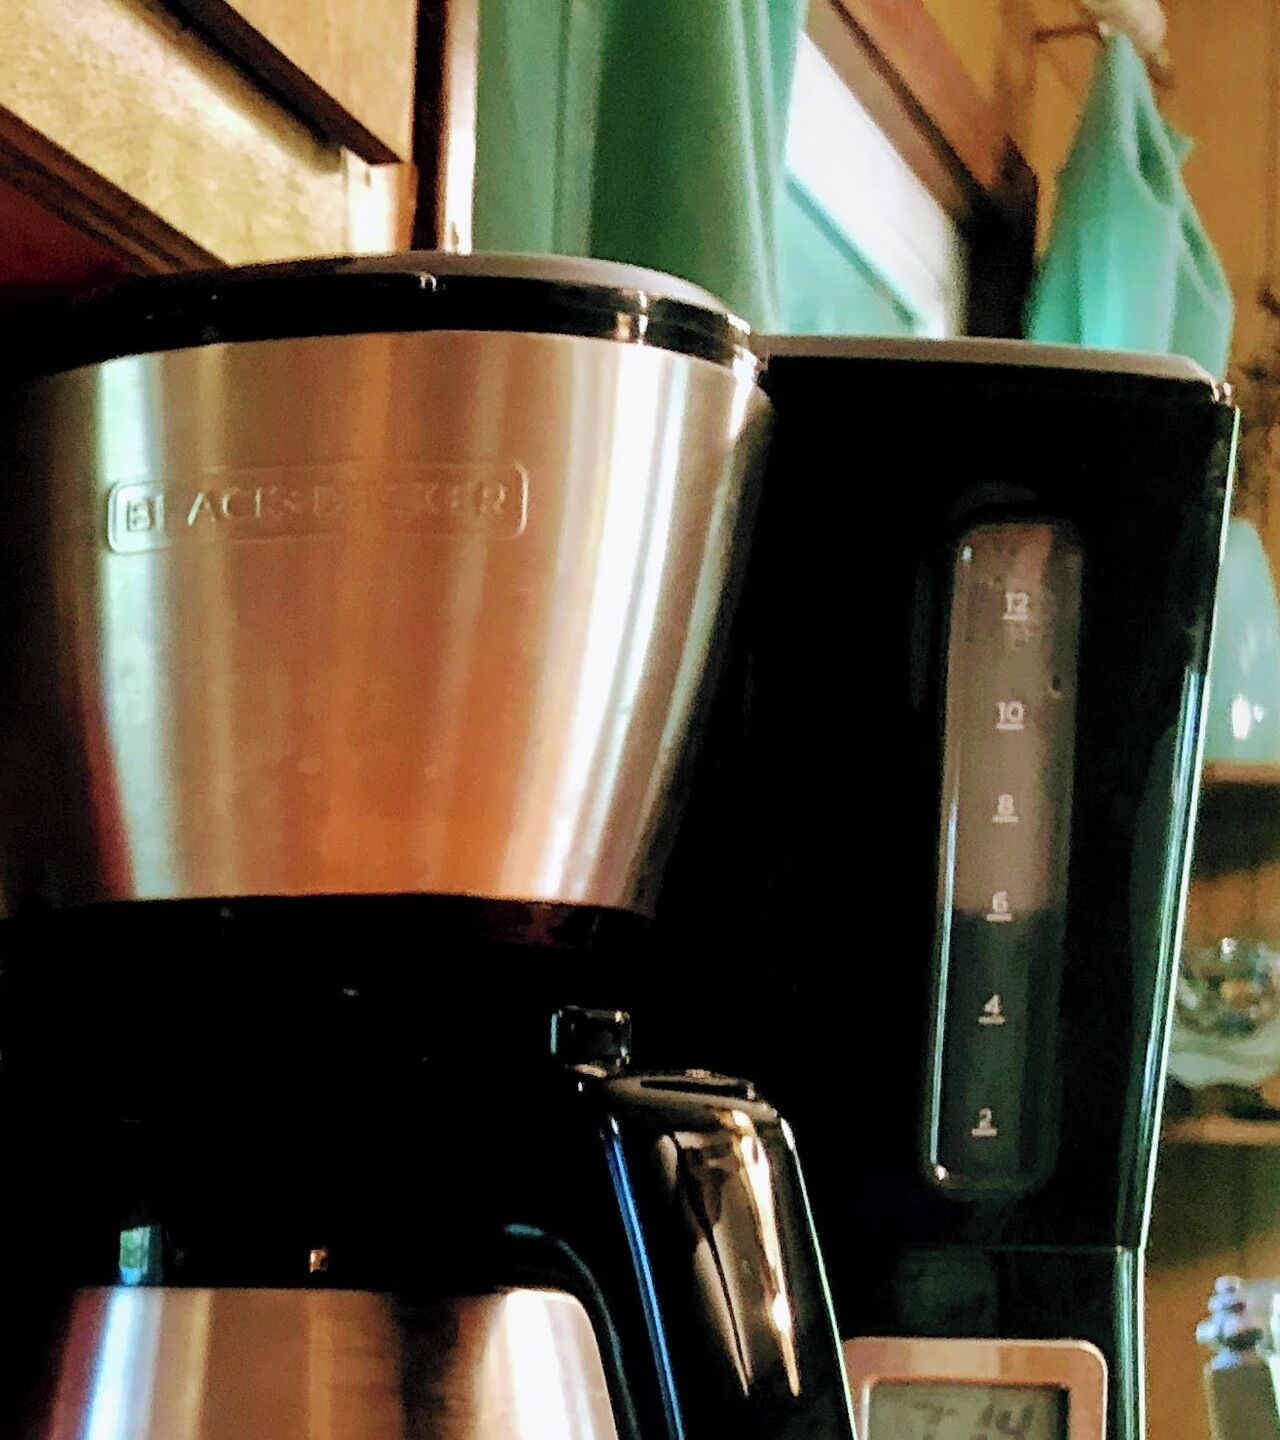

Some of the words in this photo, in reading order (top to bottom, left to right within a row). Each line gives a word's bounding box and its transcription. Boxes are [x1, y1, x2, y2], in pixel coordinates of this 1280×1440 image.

[1005, 592, 1030, 613] 12
[997, 702, 1024, 723] 10
[997, 793, 1015, 814] 8
[992, 891, 1009, 913] 6
[983, 994, 1003, 1015] 4
[978, 1108, 994, 1130] 2
